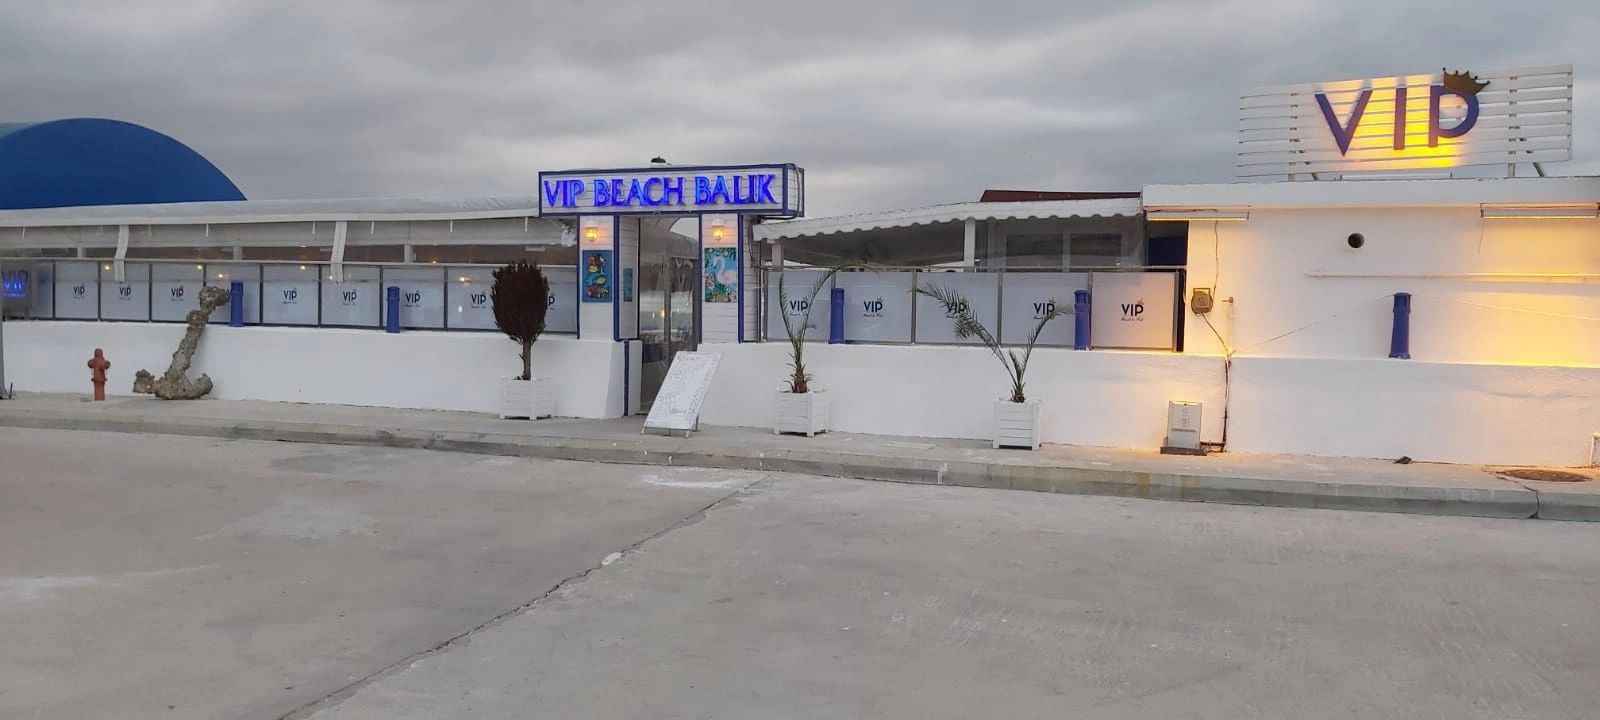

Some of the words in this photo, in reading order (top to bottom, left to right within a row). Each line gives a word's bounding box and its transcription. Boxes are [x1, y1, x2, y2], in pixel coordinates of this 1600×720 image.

[1314, 85, 1481, 157] VIP
[543, 179, 585, 208] VIP
[593, 176, 686, 208] BEACH
[694, 173, 778, 206] BALIK
[72, 286, 86, 296] VIP
[119, 287, 132, 297] VIP
[171, 288, 184, 298] VIP
[283, 290, 298, 300] VIP
[343, 291, 357, 302] VIP
[405, 293, 421, 303] VIP
[471, 294, 487, 304] VIP
[790, 300, 809, 312] VIP
[863, 300, 884, 313] VIP
[1033, 302, 1056, 315] VIP
[1121, 303, 1144, 316] VIP
